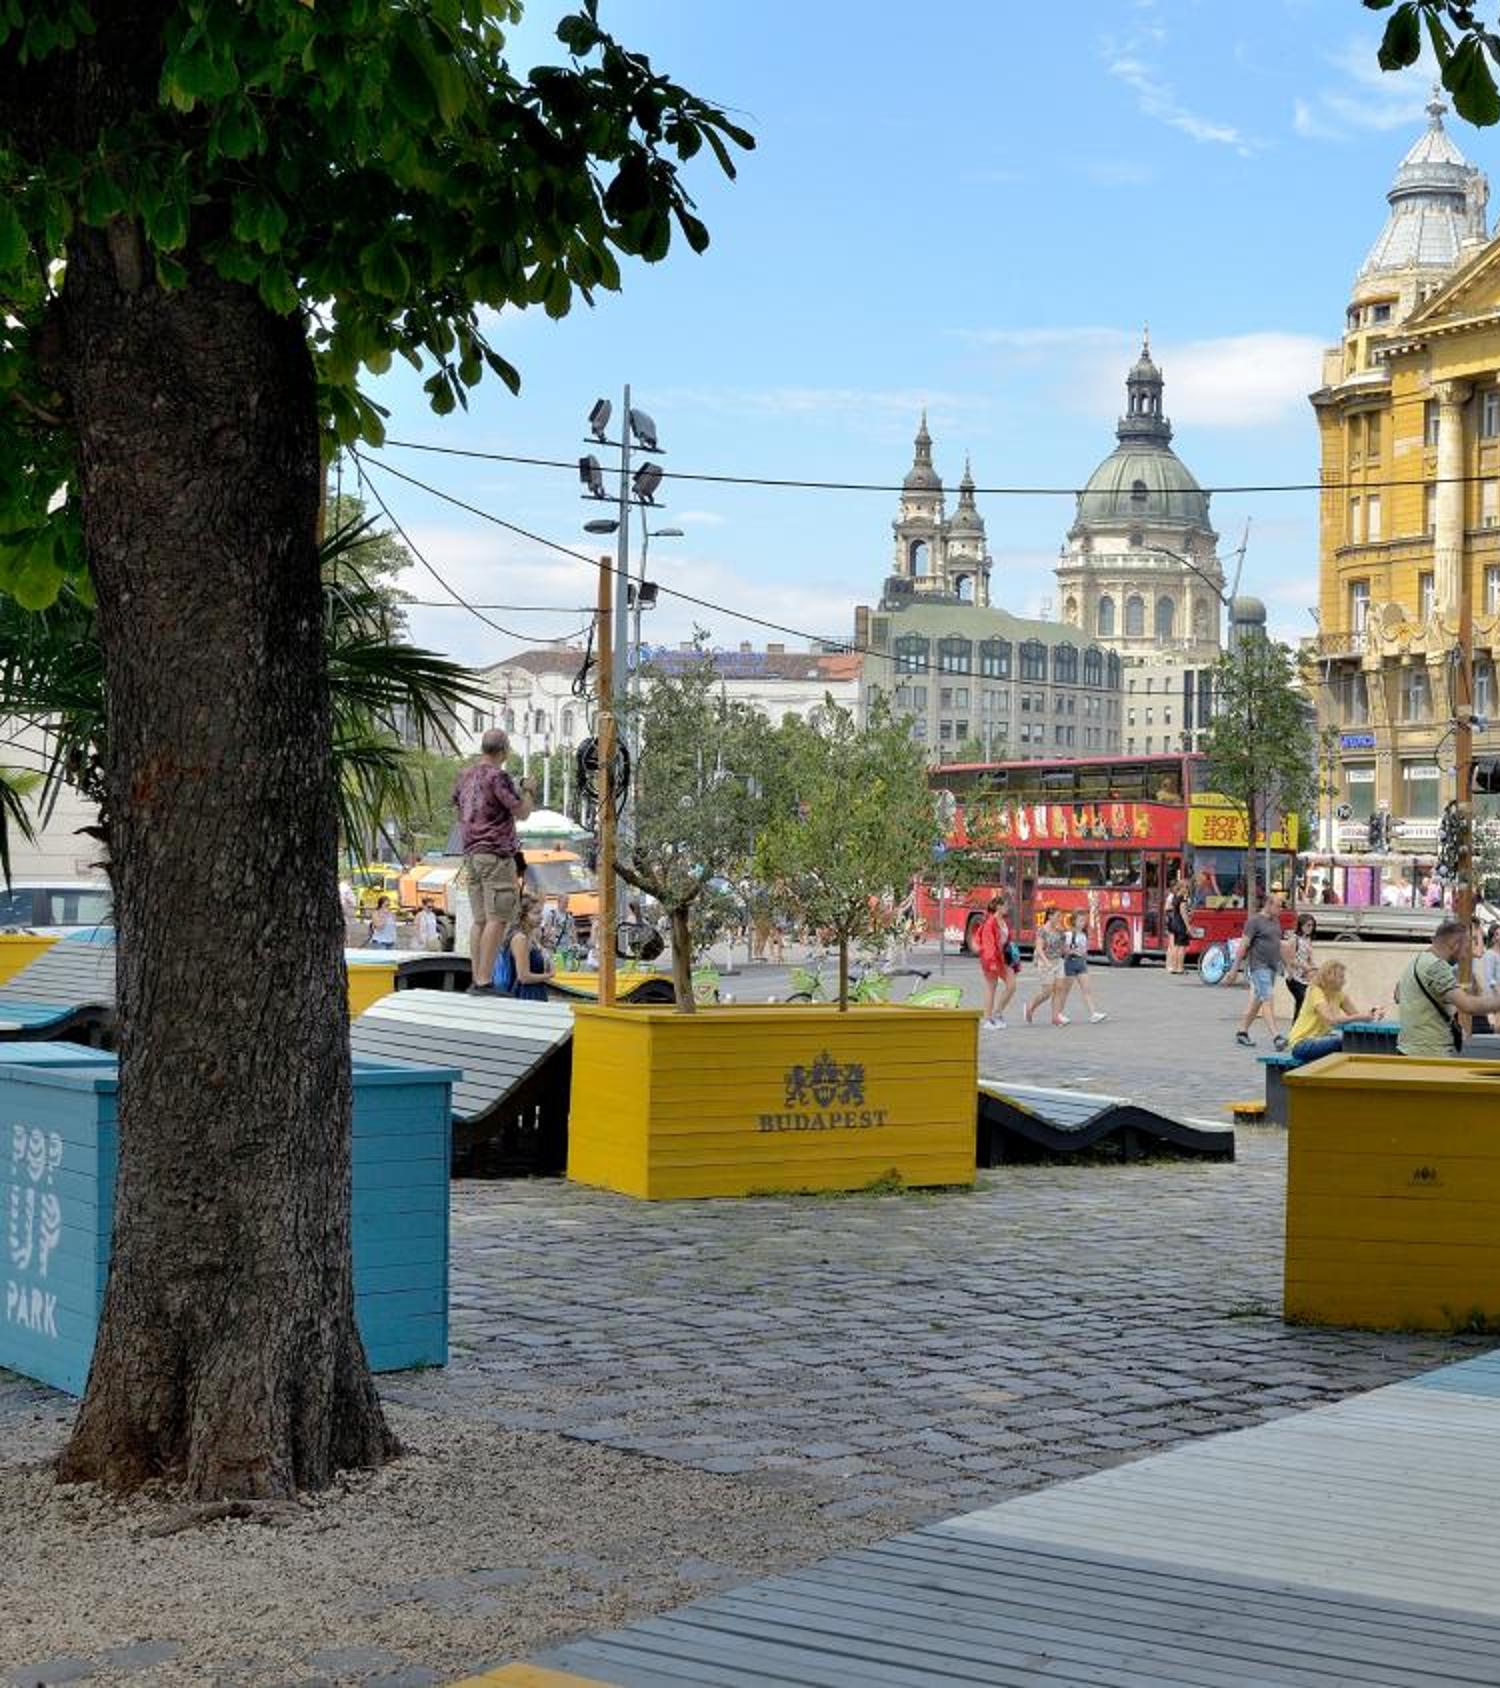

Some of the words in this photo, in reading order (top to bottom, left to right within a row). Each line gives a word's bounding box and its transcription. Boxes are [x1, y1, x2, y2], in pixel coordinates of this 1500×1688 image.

[1202, 830, 1237, 842] HOP
[1204, 815, 1238, 829] HOP
[757, 1109, 888, 1132] BUDAPEST
[13, 1123, 63, 1184] POP
[9, 1184, 62, 1279] UP
[7, 1279, 58, 1338] PARK
